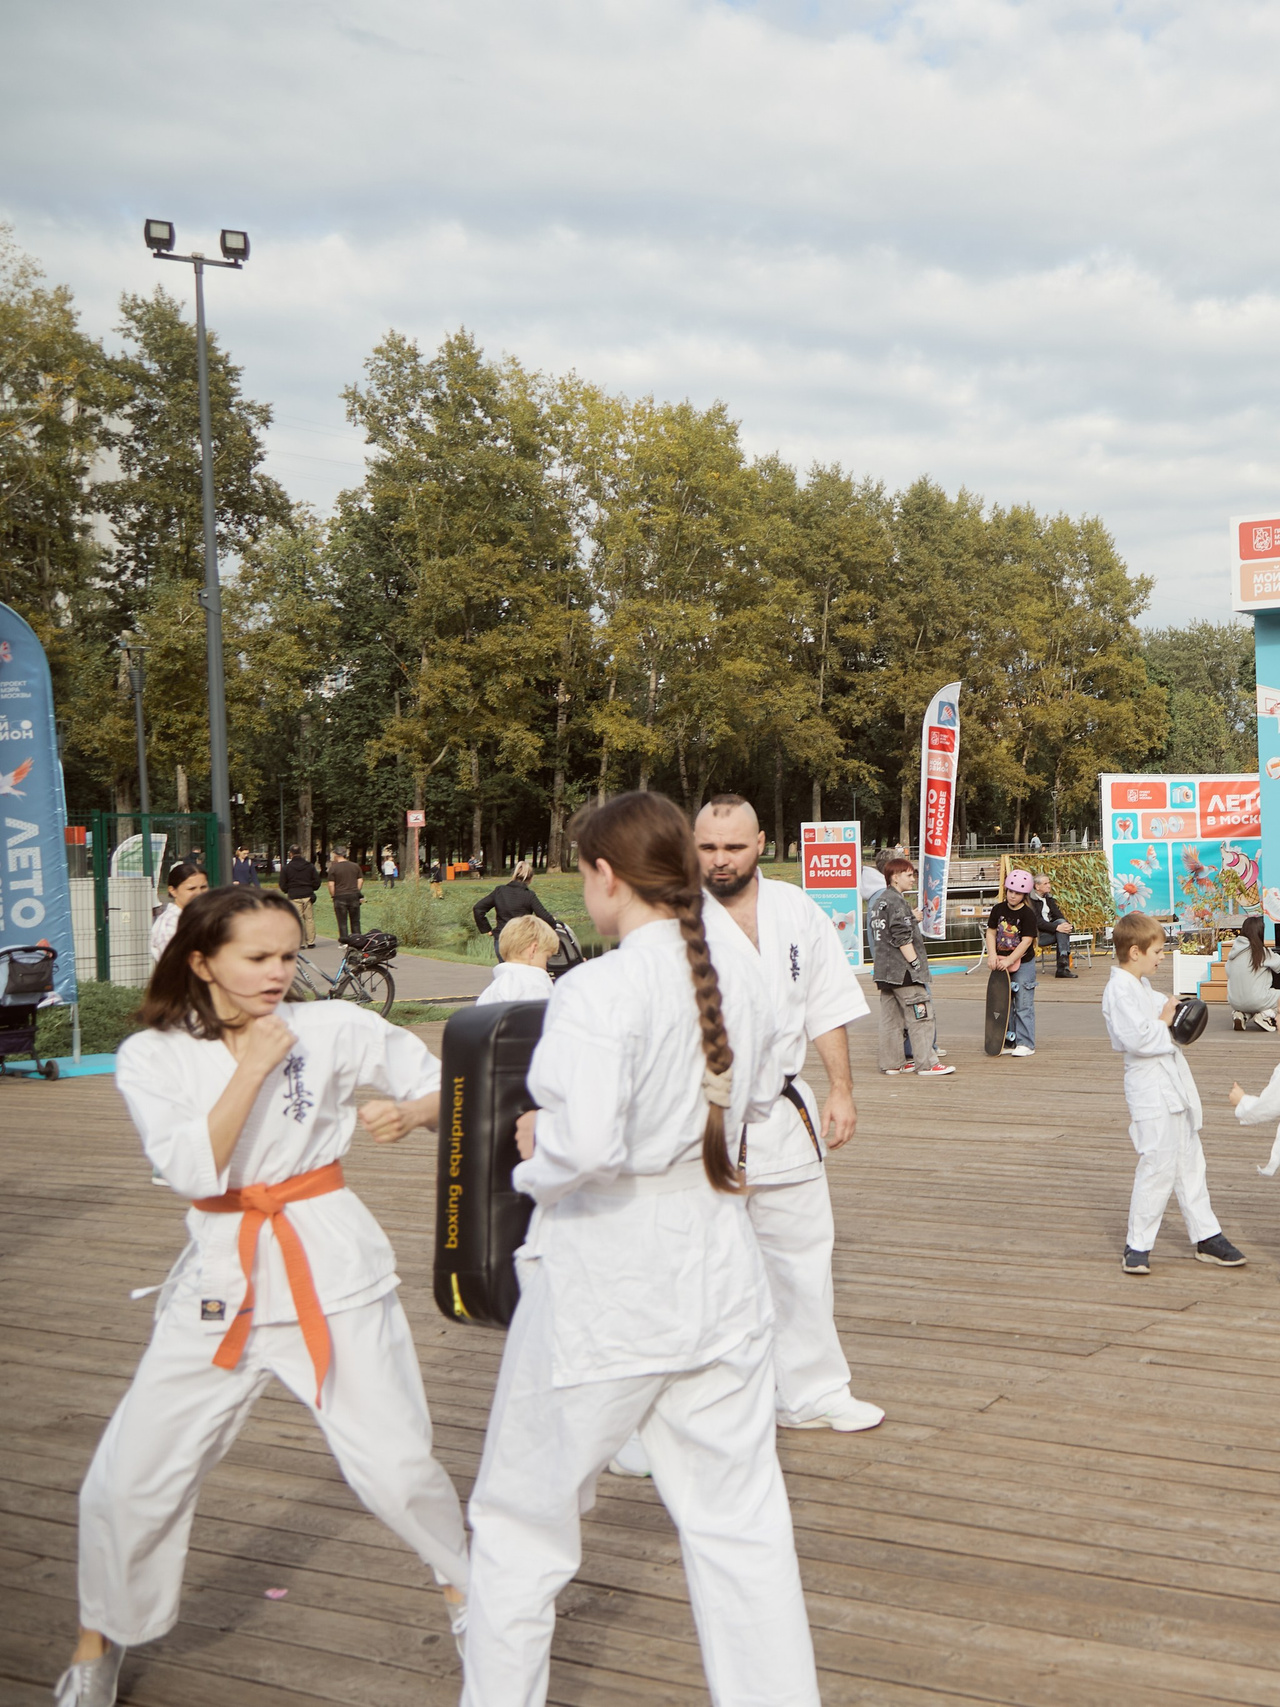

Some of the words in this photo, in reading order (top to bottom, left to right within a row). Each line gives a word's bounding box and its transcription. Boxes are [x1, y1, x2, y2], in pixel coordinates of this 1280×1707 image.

[926, 788, 938, 844] ЛЕТО
[935, 790, 947, 836] МОСКВЕ
[1206, 815, 1217, 825] В
[1220, 814, 1261, 825] МОСК
[809, 854, 852, 868] ЛЕТО
[934, 838, 942, 846] В
[4, 816, 46, 929] ЛЕТО
[817, 869, 852, 877] МОСКВЕ
[449, 1076, 465, 1178] equipment
[445, 1184, 463, 1249] boxing
